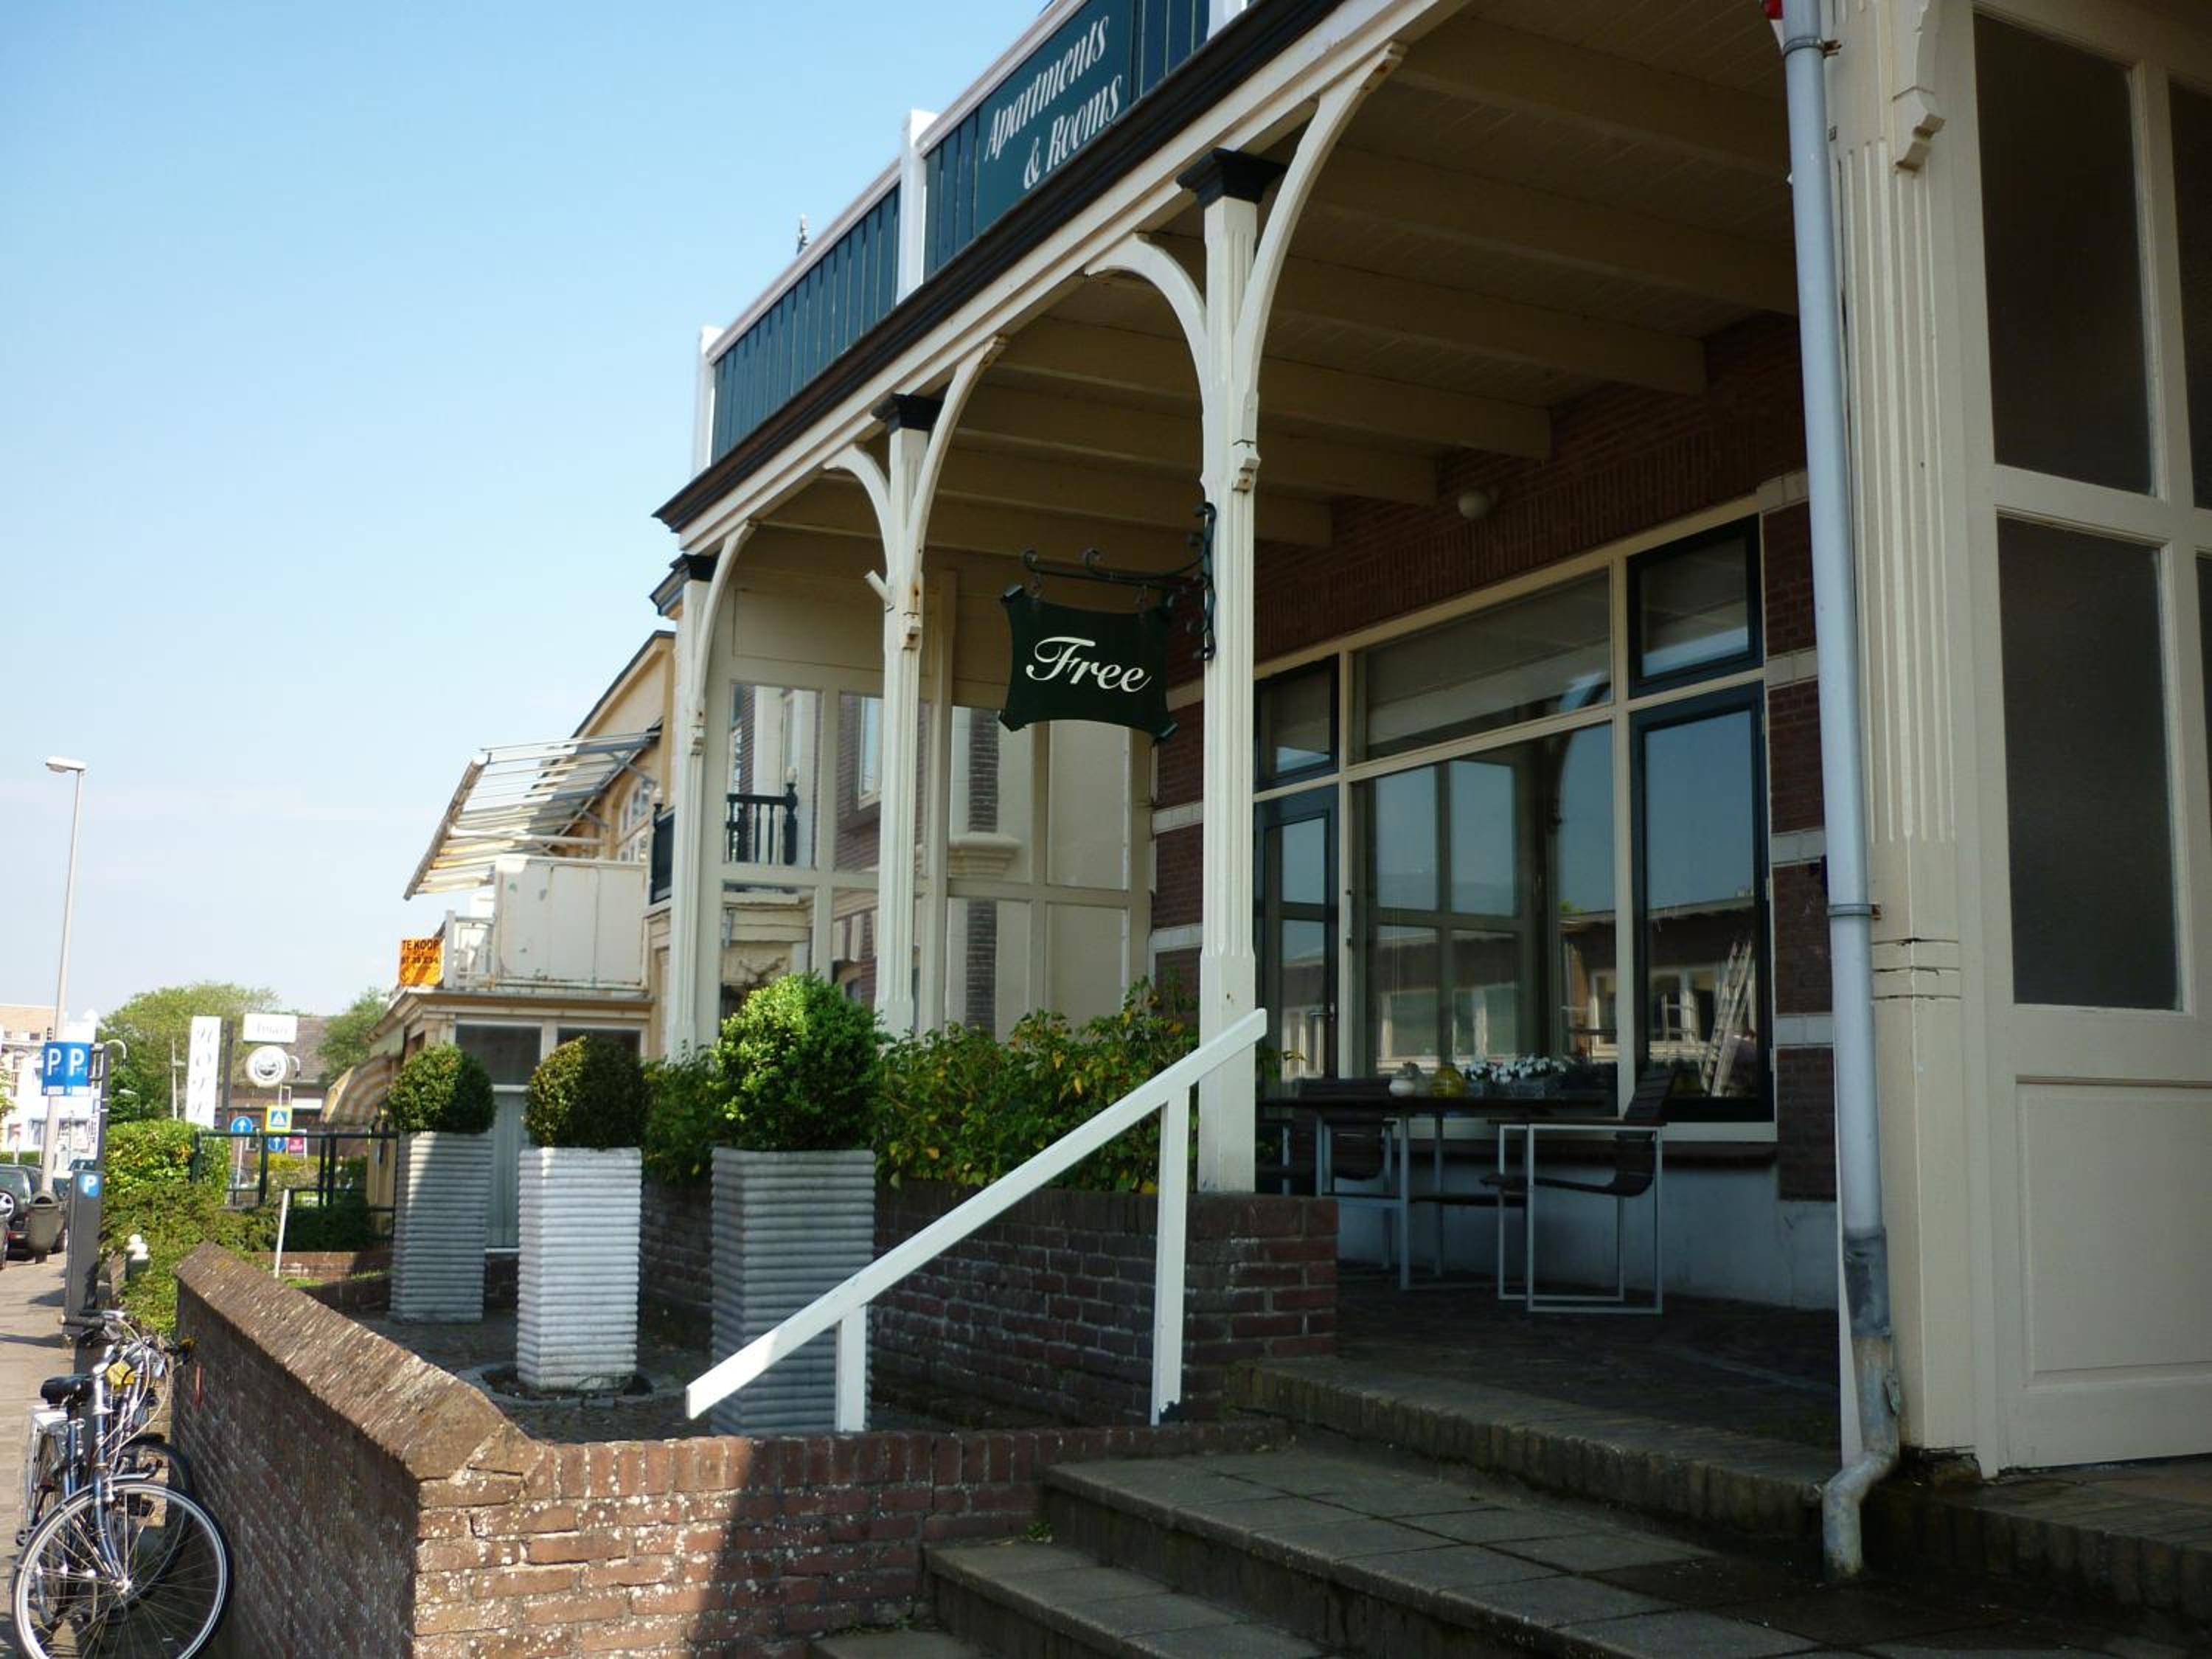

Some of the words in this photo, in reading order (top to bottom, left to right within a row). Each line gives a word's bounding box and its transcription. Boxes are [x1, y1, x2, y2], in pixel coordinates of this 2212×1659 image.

[985, 15, 1109, 160] Apartments
[1023, 136, 1040, 189] &
[1046, 74, 1121, 173] Rooms
[1026, 636, 1152, 692] Free
[402, 940, 412, 950] TE
[414, 939, 439, 950] KOOP
[48, 1048, 61, 1077] P
[69, 1047, 85, 1077] P
[83, 1176, 97, 1194] P
